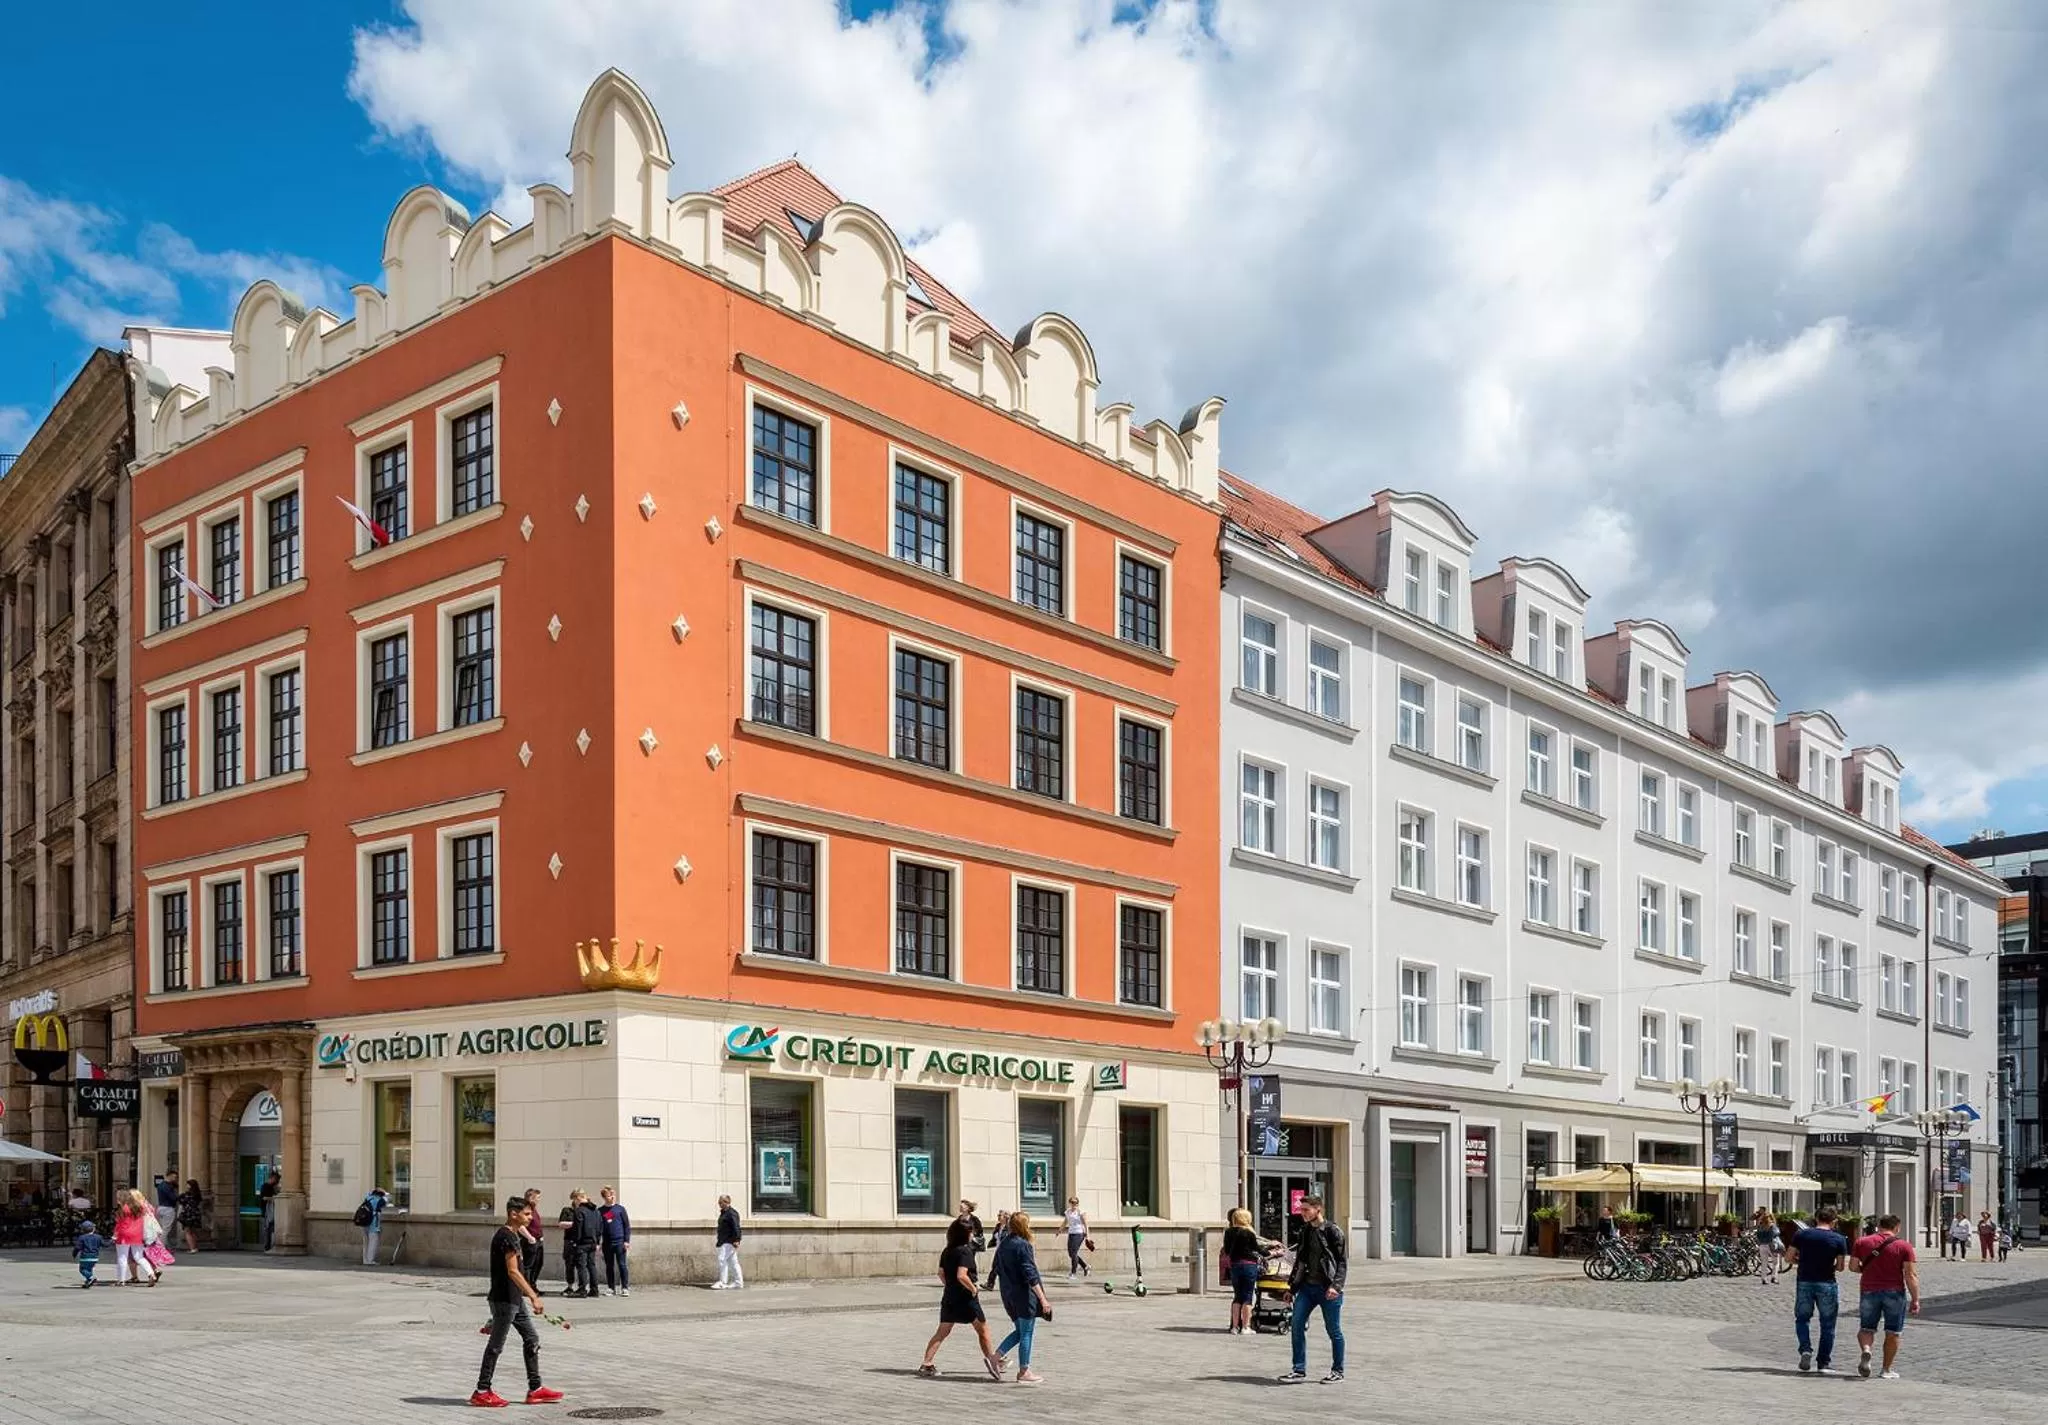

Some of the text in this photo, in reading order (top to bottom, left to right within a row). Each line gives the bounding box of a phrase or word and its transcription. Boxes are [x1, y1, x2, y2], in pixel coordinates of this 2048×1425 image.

[356, 1031, 448, 1064] CRÉDIT
[456, 1019, 605, 1056] AGRICOLE
[786, 1036, 915, 1071] CRÉDIT
[923, 1049, 1074, 1084] AGRICOLE
[80, 1086, 138, 1100] CABARET
[89, 1099, 130, 1112] SHOW
[1819, 1133, 1849, 1144] HOTEL
